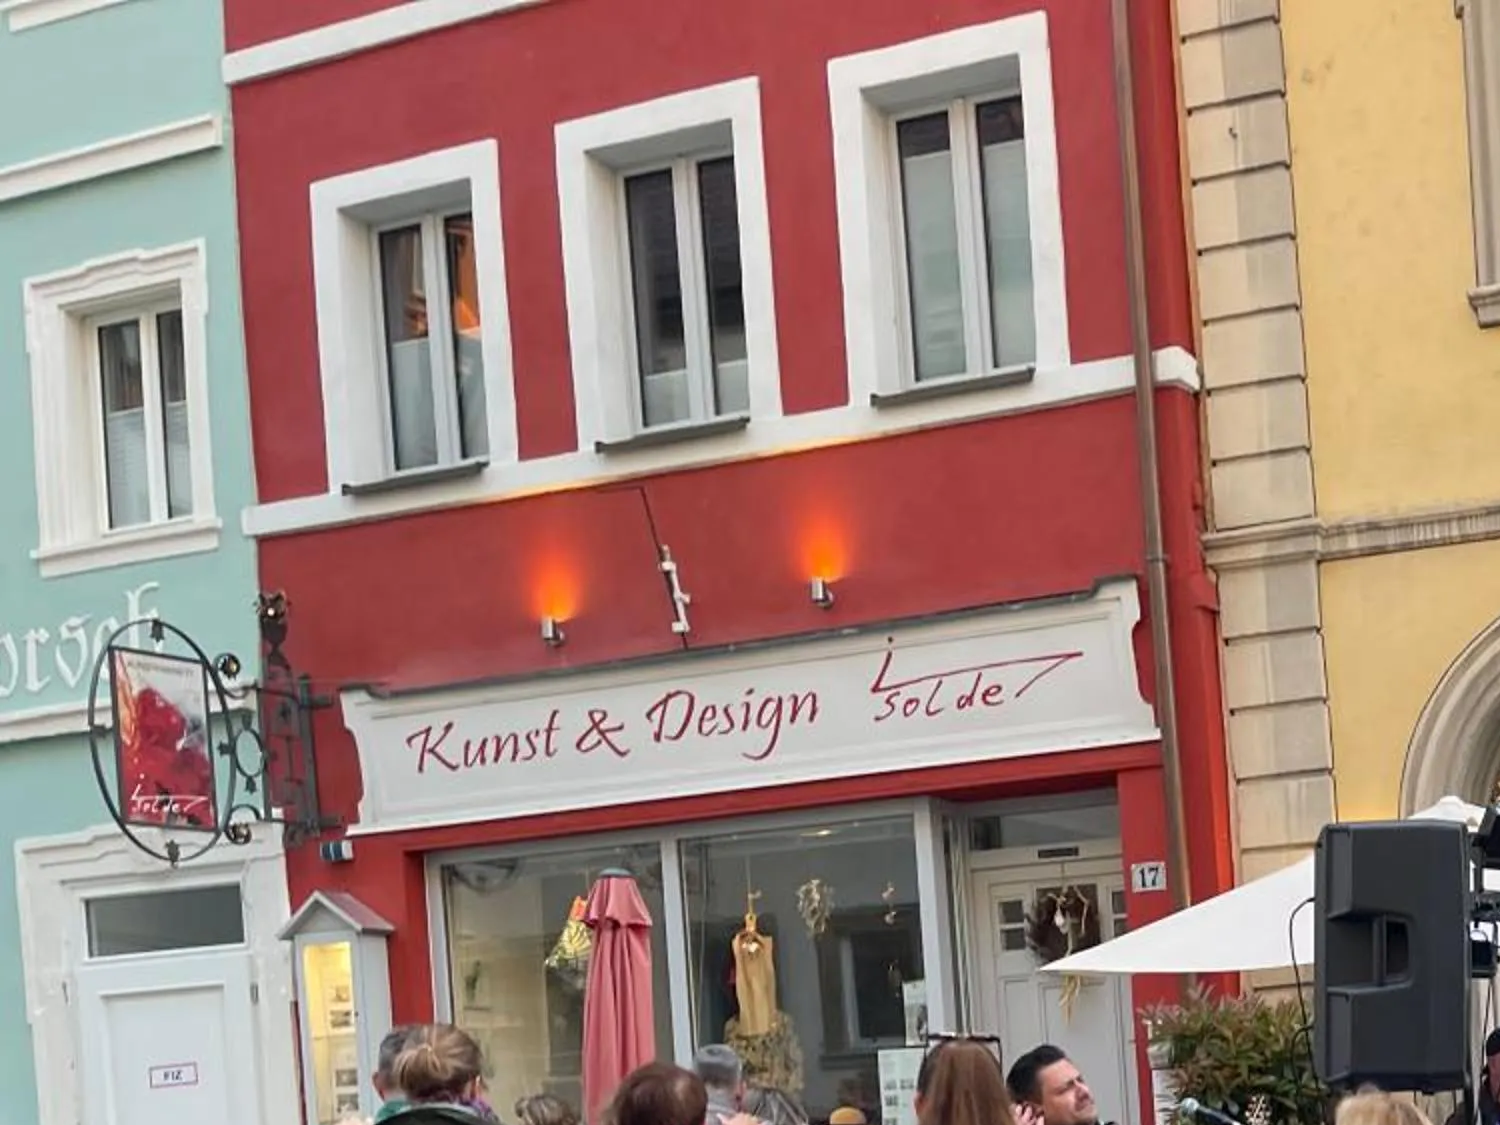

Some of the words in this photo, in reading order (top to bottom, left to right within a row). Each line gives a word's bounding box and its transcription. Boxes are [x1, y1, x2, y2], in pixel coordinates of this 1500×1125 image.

[406, 709, 561, 773] Kunst
[574, 709, 630, 757] &
[646, 688, 820, 762] Design
[1139, 867, 1158, 888] 17
